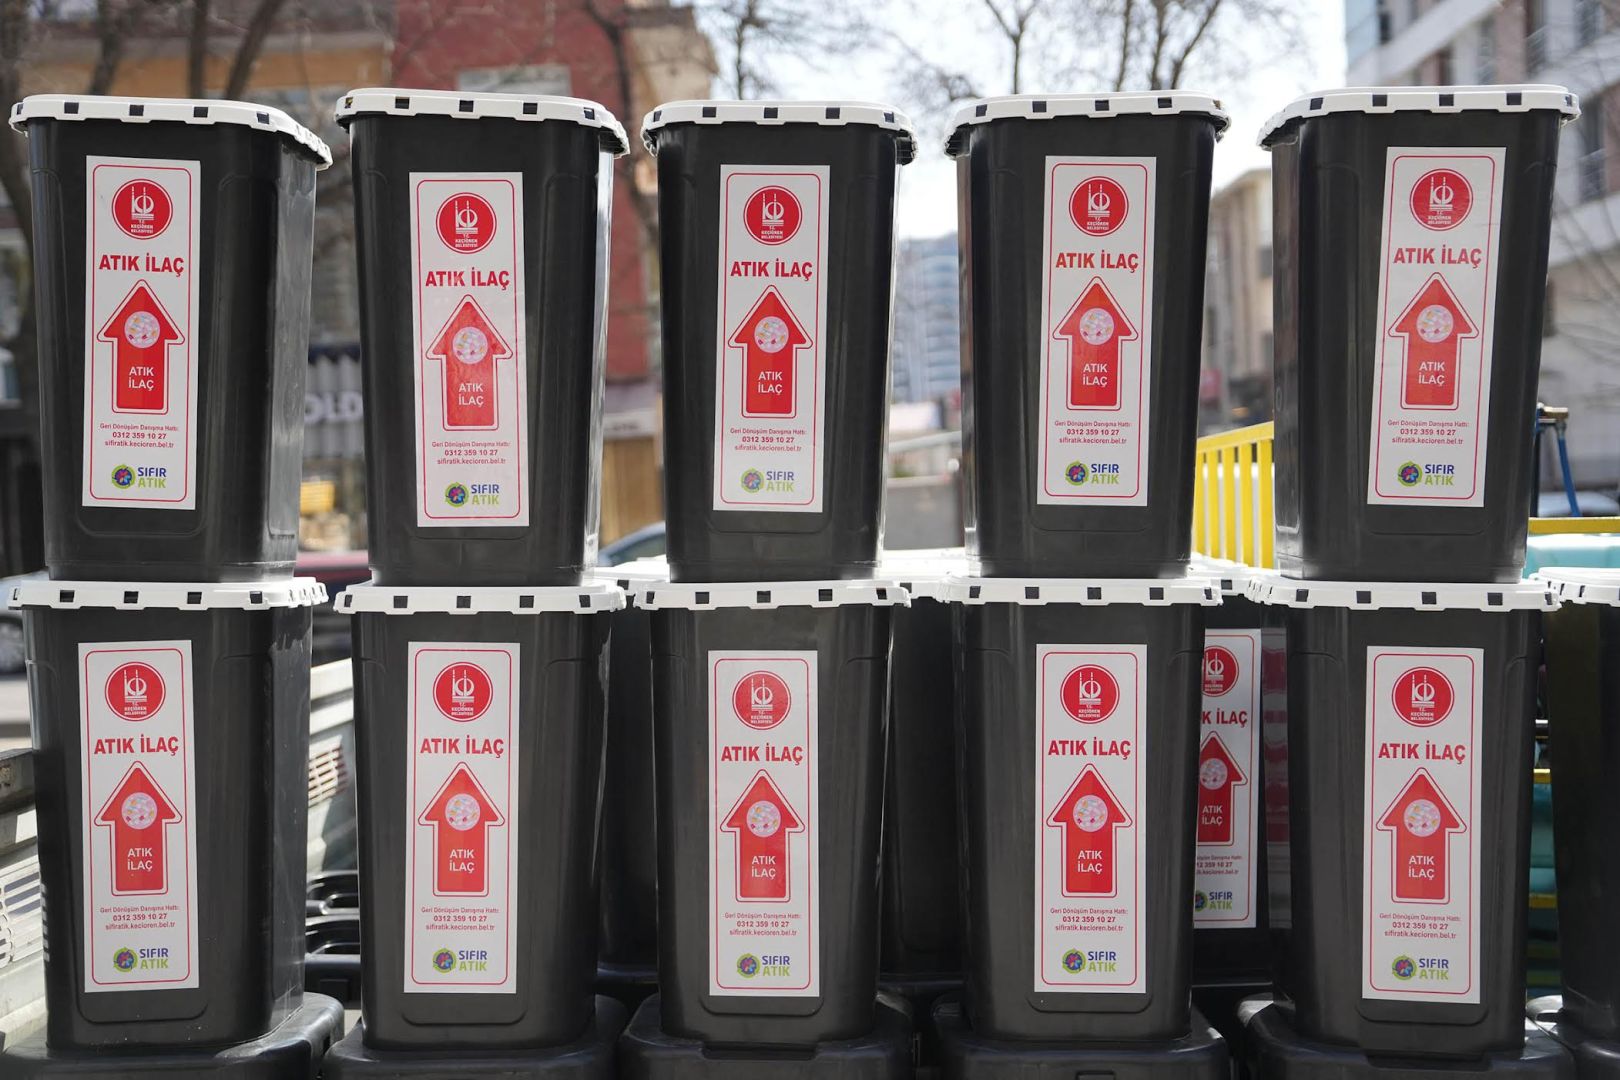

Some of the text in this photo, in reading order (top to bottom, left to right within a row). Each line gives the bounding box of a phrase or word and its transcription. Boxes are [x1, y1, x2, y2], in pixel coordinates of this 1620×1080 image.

[1055, 249, 1139, 273] ATIK İLAÇ
[1393, 244, 1482, 269] ATIK İLAÇ
[98, 252, 184, 278] ATIK İLAÇ
[730, 258, 813, 282] ATIK İLAÇ
[425, 267, 509, 291] ATIK İLAÇ
[128, 366, 154, 377] ATIK
[1083, 363, 1108, 373] ATIK
[1419, 361, 1446, 372] ATIK
[758, 371, 783, 381] ATIK
[1082, 373, 1108, 388] İLAÇ
[1418, 372, 1445, 387] İLAÇ
[128, 377, 154, 391] İLAÇ
[458, 382, 483, 392] ATIK
[758, 381, 783, 396] İLAÇ
[458, 393, 484, 407] İLAÇ
[112, 431, 130, 439] 0312
[742, 435, 759, 443] 0312
[138, 467, 167, 477] SIFIR
[1091, 463, 1119, 474] SIFIR
[1424, 464, 1454, 475] SIFIR
[766, 470, 794, 481] SIFIR
[1091, 474, 1119, 485] ATIK
[1424, 474, 1454, 486] ATIK
[138, 477, 167, 488] ATIK
[766, 481, 794, 492] ATIK
[470, 484, 500, 494] SIFIR
[471, 494, 500, 505] ATIK
[1216, 707, 1247, 728] İLAÇ
[94, 733, 179, 756] ATIK İLAÇ
[420, 734, 504, 759] ATIK İLAÇ
[1048, 736, 1131, 760] ATIK İLAÇ
[721, 742, 803, 766] ATIK İLAÇ
[1378, 740, 1466, 765] ATIK İLAÇ
[1202, 805, 1223, 814] ATIK
[1202, 814, 1223, 826] İLAÇ
[127, 847, 153, 858] ATIK
[449, 849, 475, 859] ATIK
[1078, 850, 1103, 860] ATIK
[127, 859, 153, 872] İLAÇ
[751, 855, 776, 865] ATIK
[1409, 855, 1435, 866] ATIK
[449, 859, 475, 874] İLAÇ
[1077, 860, 1103, 875] İLAÇ
[751, 866, 776, 880] İLAÇ
[1408, 866, 1435, 881] İLAÇ
[1209, 891, 1233, 901] SIFIR
[113, 914, 131, 922] 0312
[132, 913, 146, 921] 359
[1062, 915, 1080, 923] 0312
[1392, 921, 1411, 929] 0312
[139, 947, 169, 959] SIFIR
[458, 950, 488, 961] SIFIR
[1087, 951, 1116, 961] SIFIR
[140, 958, 169, 970] ATIK
[762, 955, 790, 965] SIFIR
[1418, 958, 1449, 969] SIFIR
[459, 961, 487, 972] ATIK
[762, 965, 790, 976] ATIK
[1088, 961, 1116, 972] ATIK
[1418, 969, 1448, 981] ATIK
